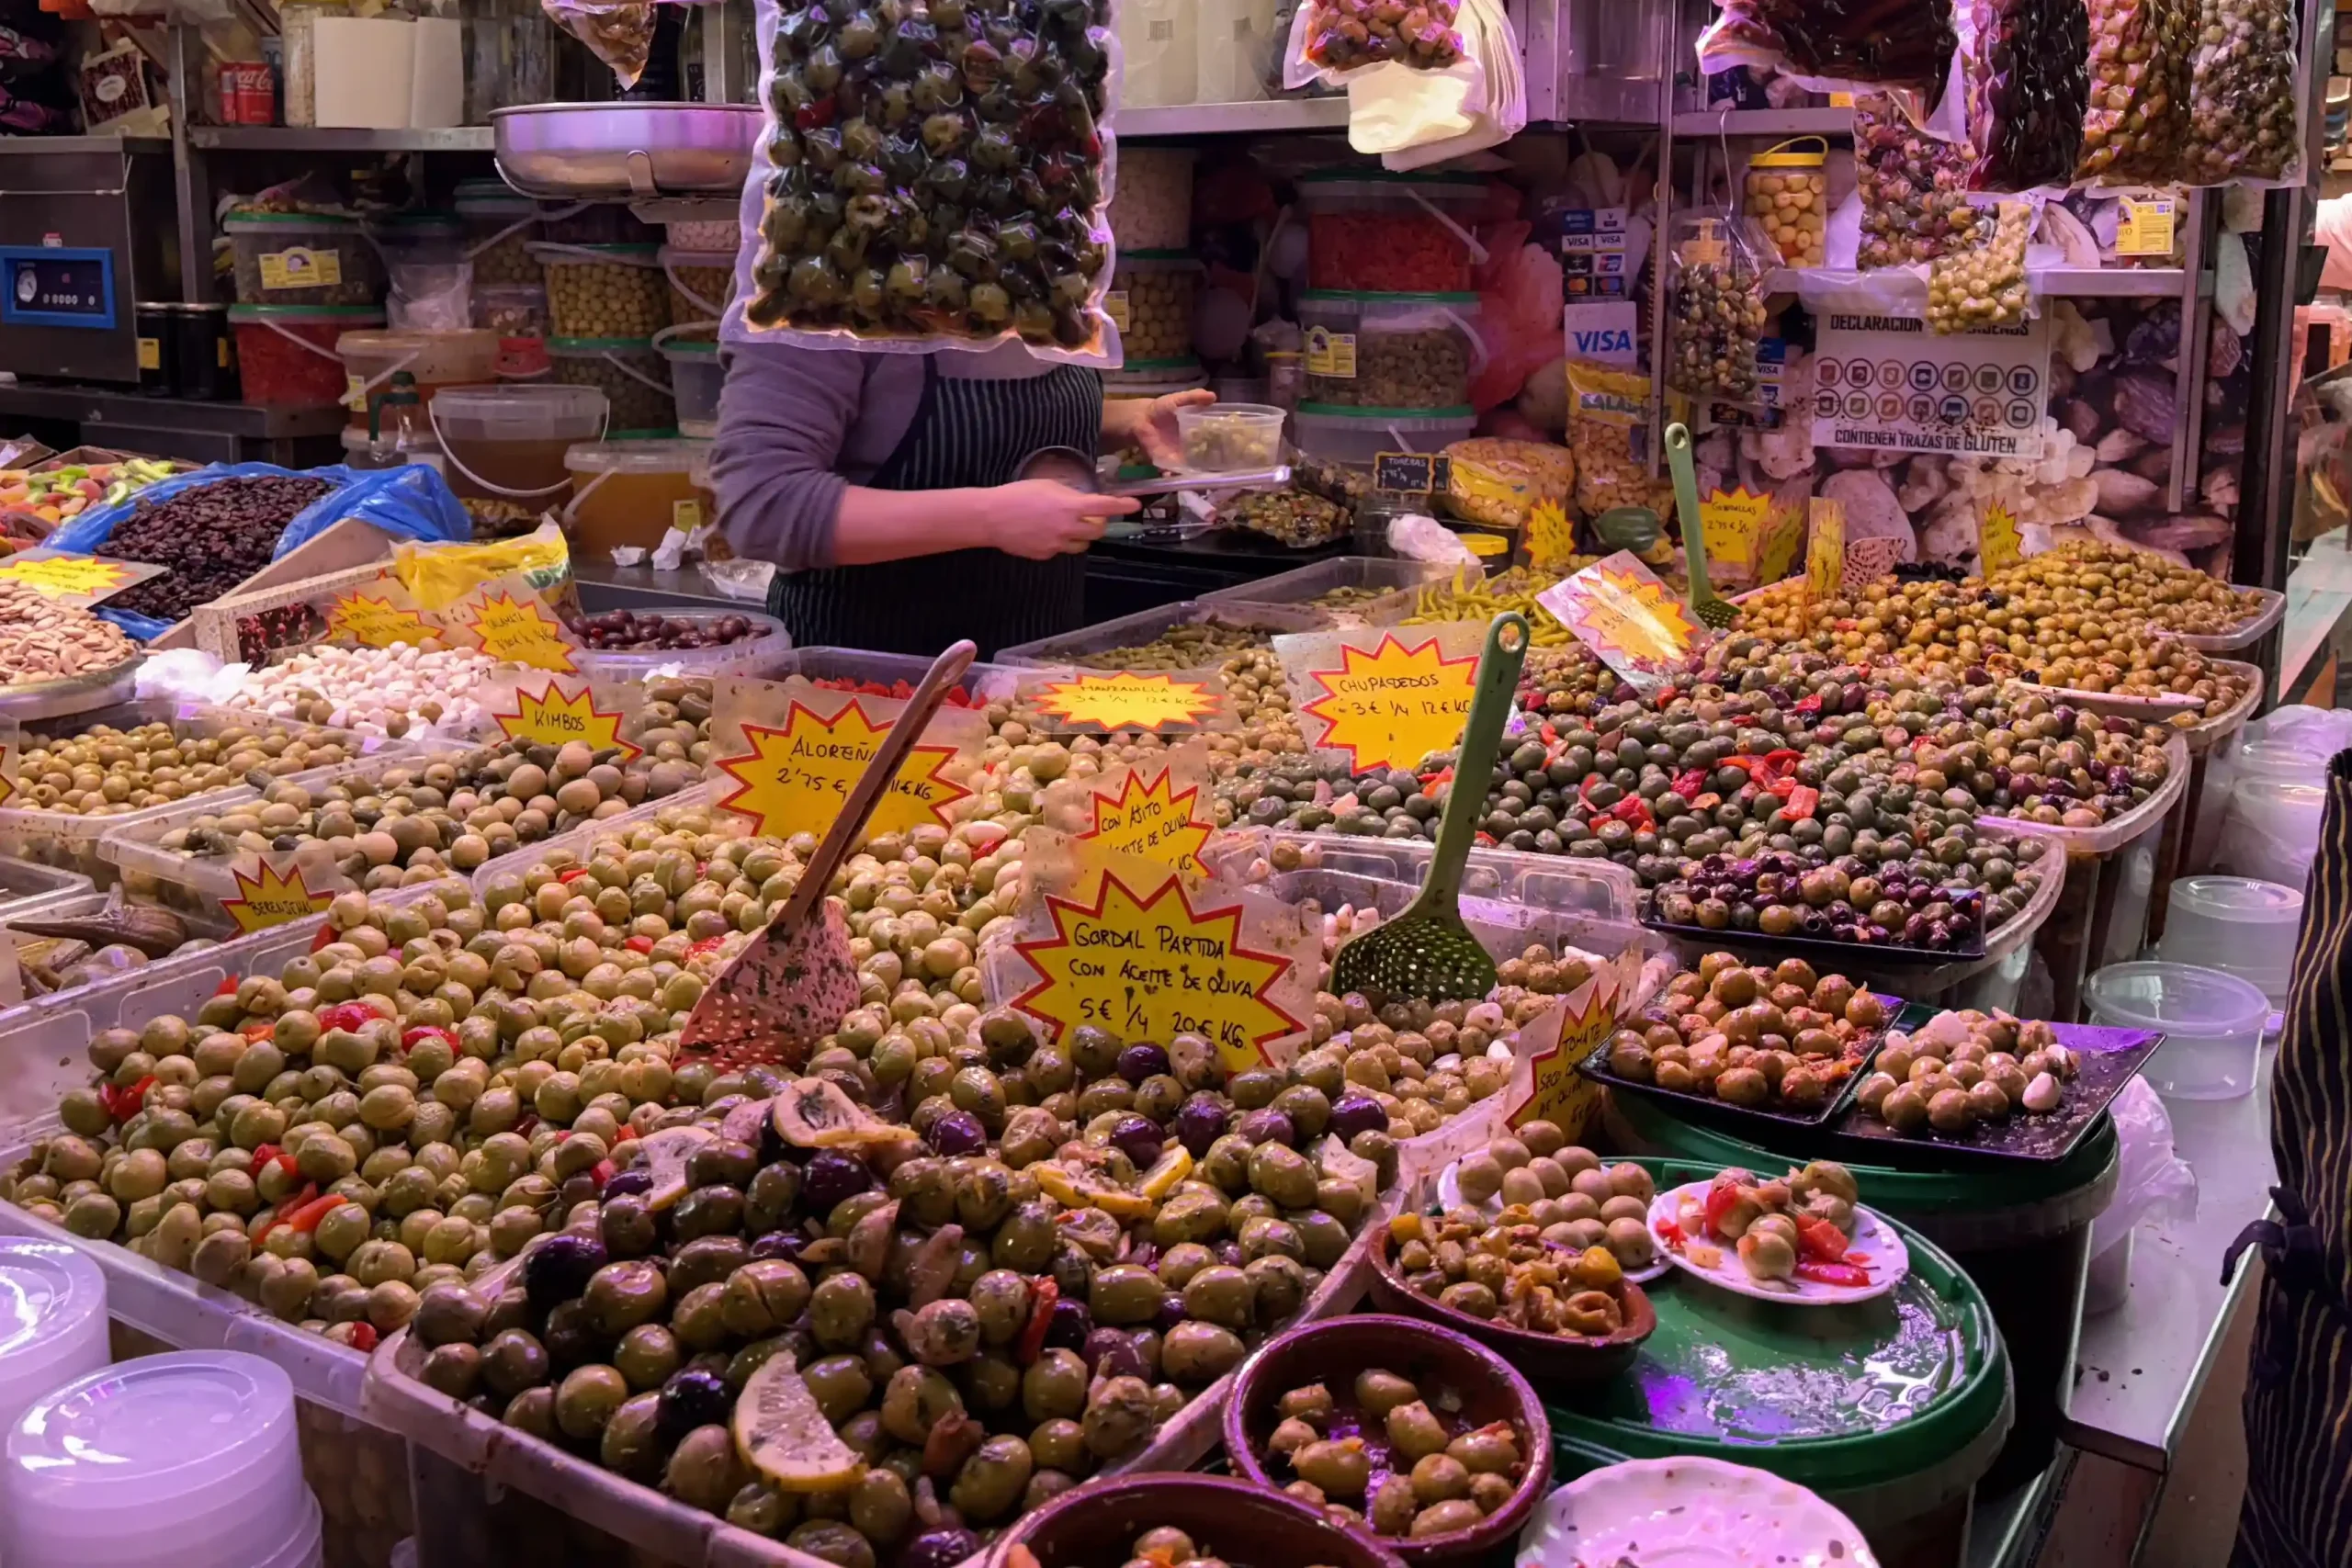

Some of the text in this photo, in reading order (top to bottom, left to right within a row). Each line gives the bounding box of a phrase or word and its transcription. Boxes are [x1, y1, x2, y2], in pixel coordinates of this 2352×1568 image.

[1567, 237, 1589, 246] VISA
[1600, 235, 1622, 243] VISA
[1830, 314, 1923, 333] DECLARACION
[1573, 330, 1632, 353] VISA
[1757, 365, 1779, 375] VISA
[1835, 429, 2017, 454] CONTIENEN TRAZAS DE GLUTEN
[534, 709, 585, 732] KIMBOS
[1389, 700, 1409, 716] 1/4
[791, 735, 876, 762] ALOREÑ
[776, 767, 827, 792] 2'75
[1101, 801, 1161, 832] CON AJITO
[1148, 831, 1159, 847] DE
[1162, 812, 1189, 837] OLIVA
[1074, 922, 1226, 961] GORDAL PARTIDA
[1069, 959, 1255, 999] CON ACEITE DE OLIVA
[1125, 990, 1148, 1035] 1/4
[1562, 1022, 1601, 1057] TOMATE
